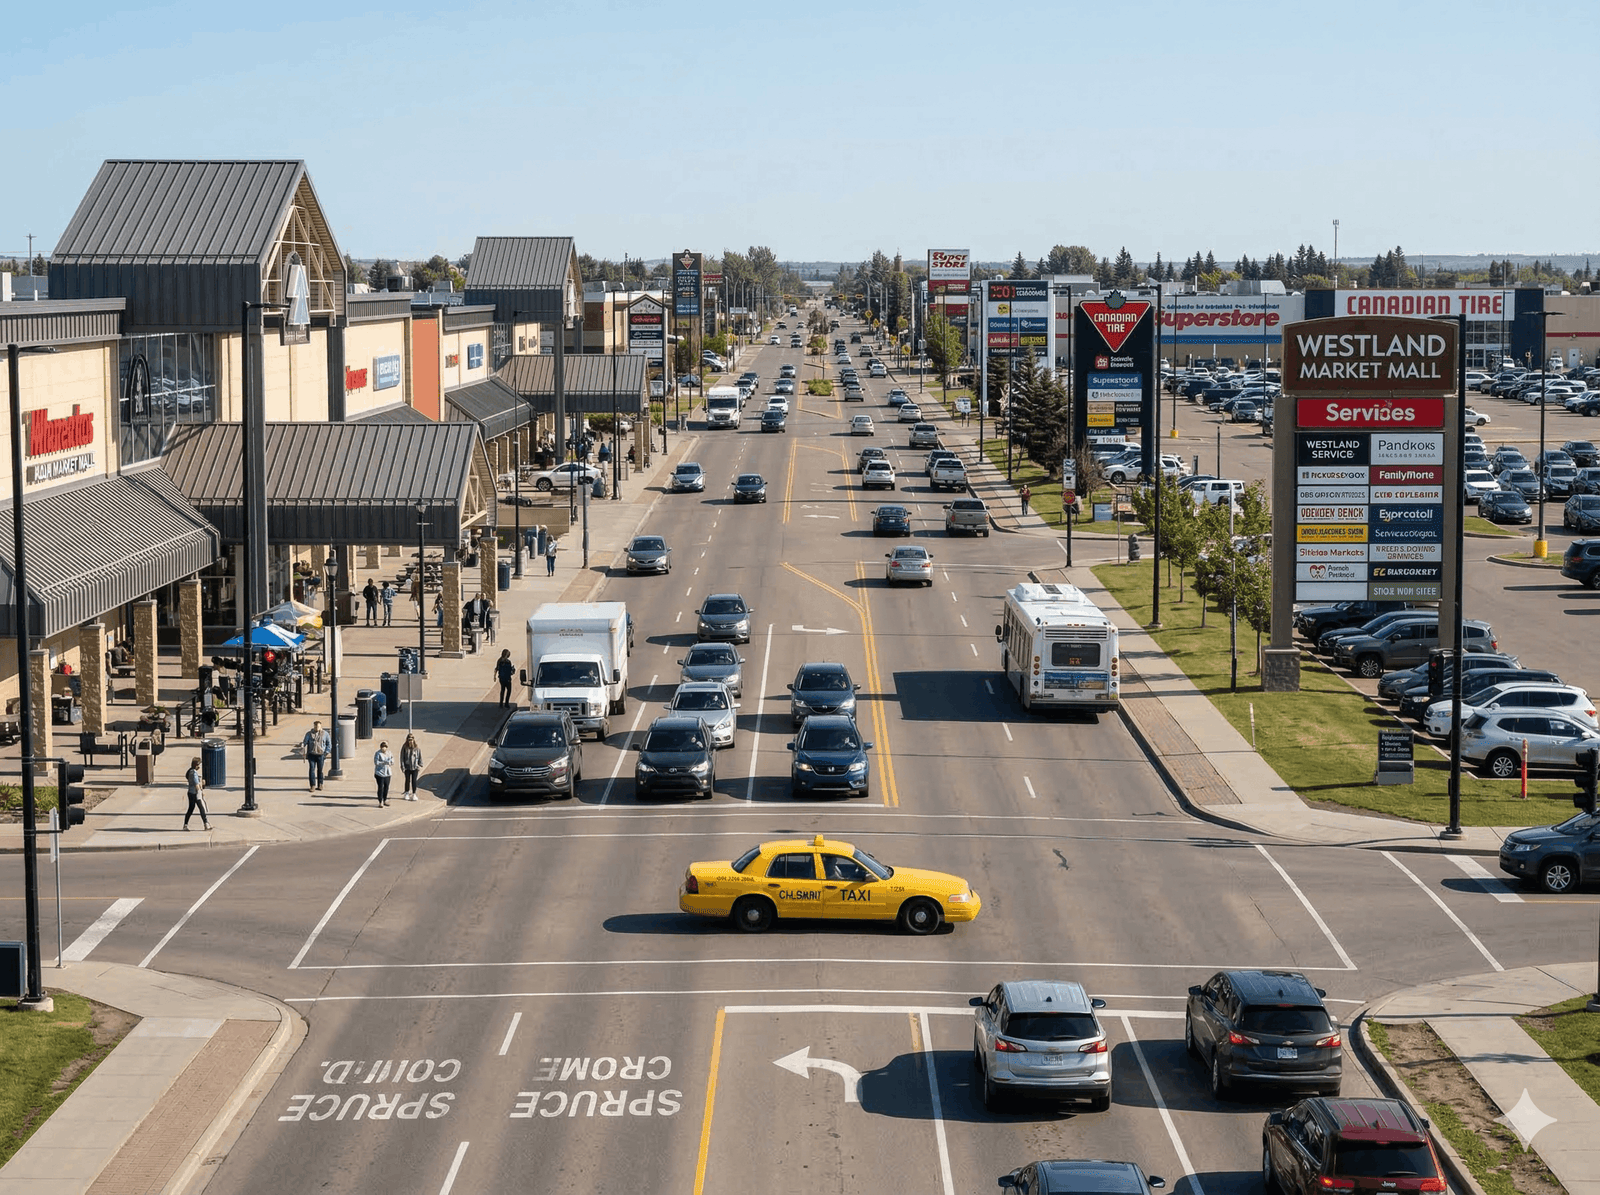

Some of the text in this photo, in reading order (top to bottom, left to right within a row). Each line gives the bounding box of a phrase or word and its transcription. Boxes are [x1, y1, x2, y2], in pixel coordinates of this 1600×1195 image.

[1347, 295, 1503, 315] CANADIAN TIRE
[1093, 313, 1138, 323] CANADIAN
[1155, 309, 1280, 331] Superstore
[1106, 323, 1126, 333] TIRE
[1296, 334, 1446, 357] WESTLAND
[1300, 362, 1441, 379] MARKET MALL
[1306, 440, 1360, 449] WESTLAND
[840, 889, 871, 902] TAXI
[278, 1092, 457, 1123] SPRUCE
[509, 1088, 684, 1119] SPRUCE
